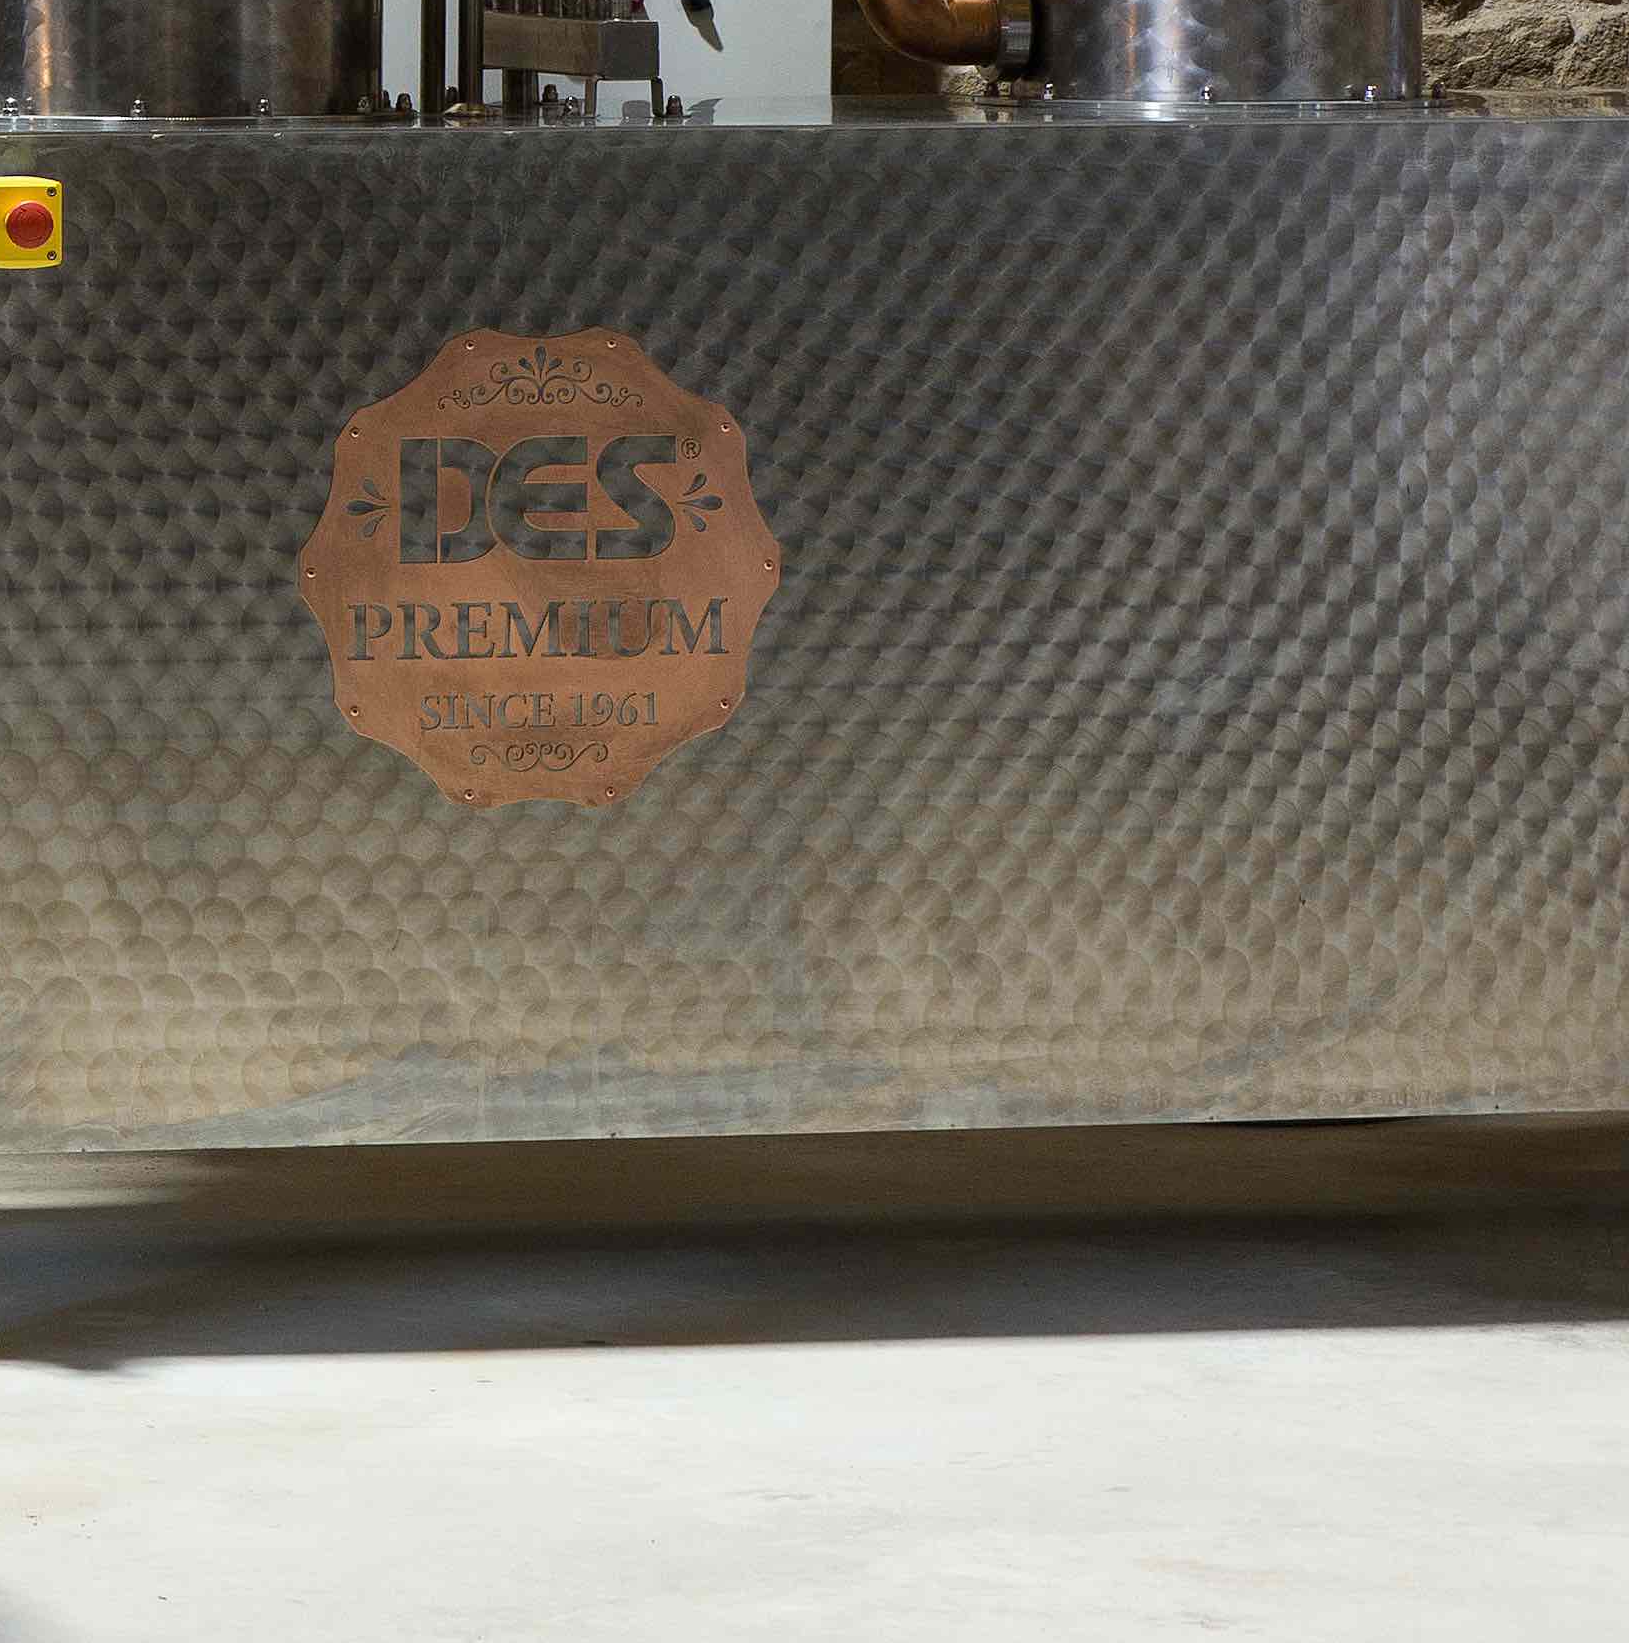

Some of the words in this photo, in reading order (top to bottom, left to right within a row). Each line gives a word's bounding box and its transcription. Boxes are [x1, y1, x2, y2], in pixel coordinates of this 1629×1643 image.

[346, 596, 732, 661] PREMIUM
[419, 691, 555, 731] SINCE
[569, 690, 660, 729] 1961
